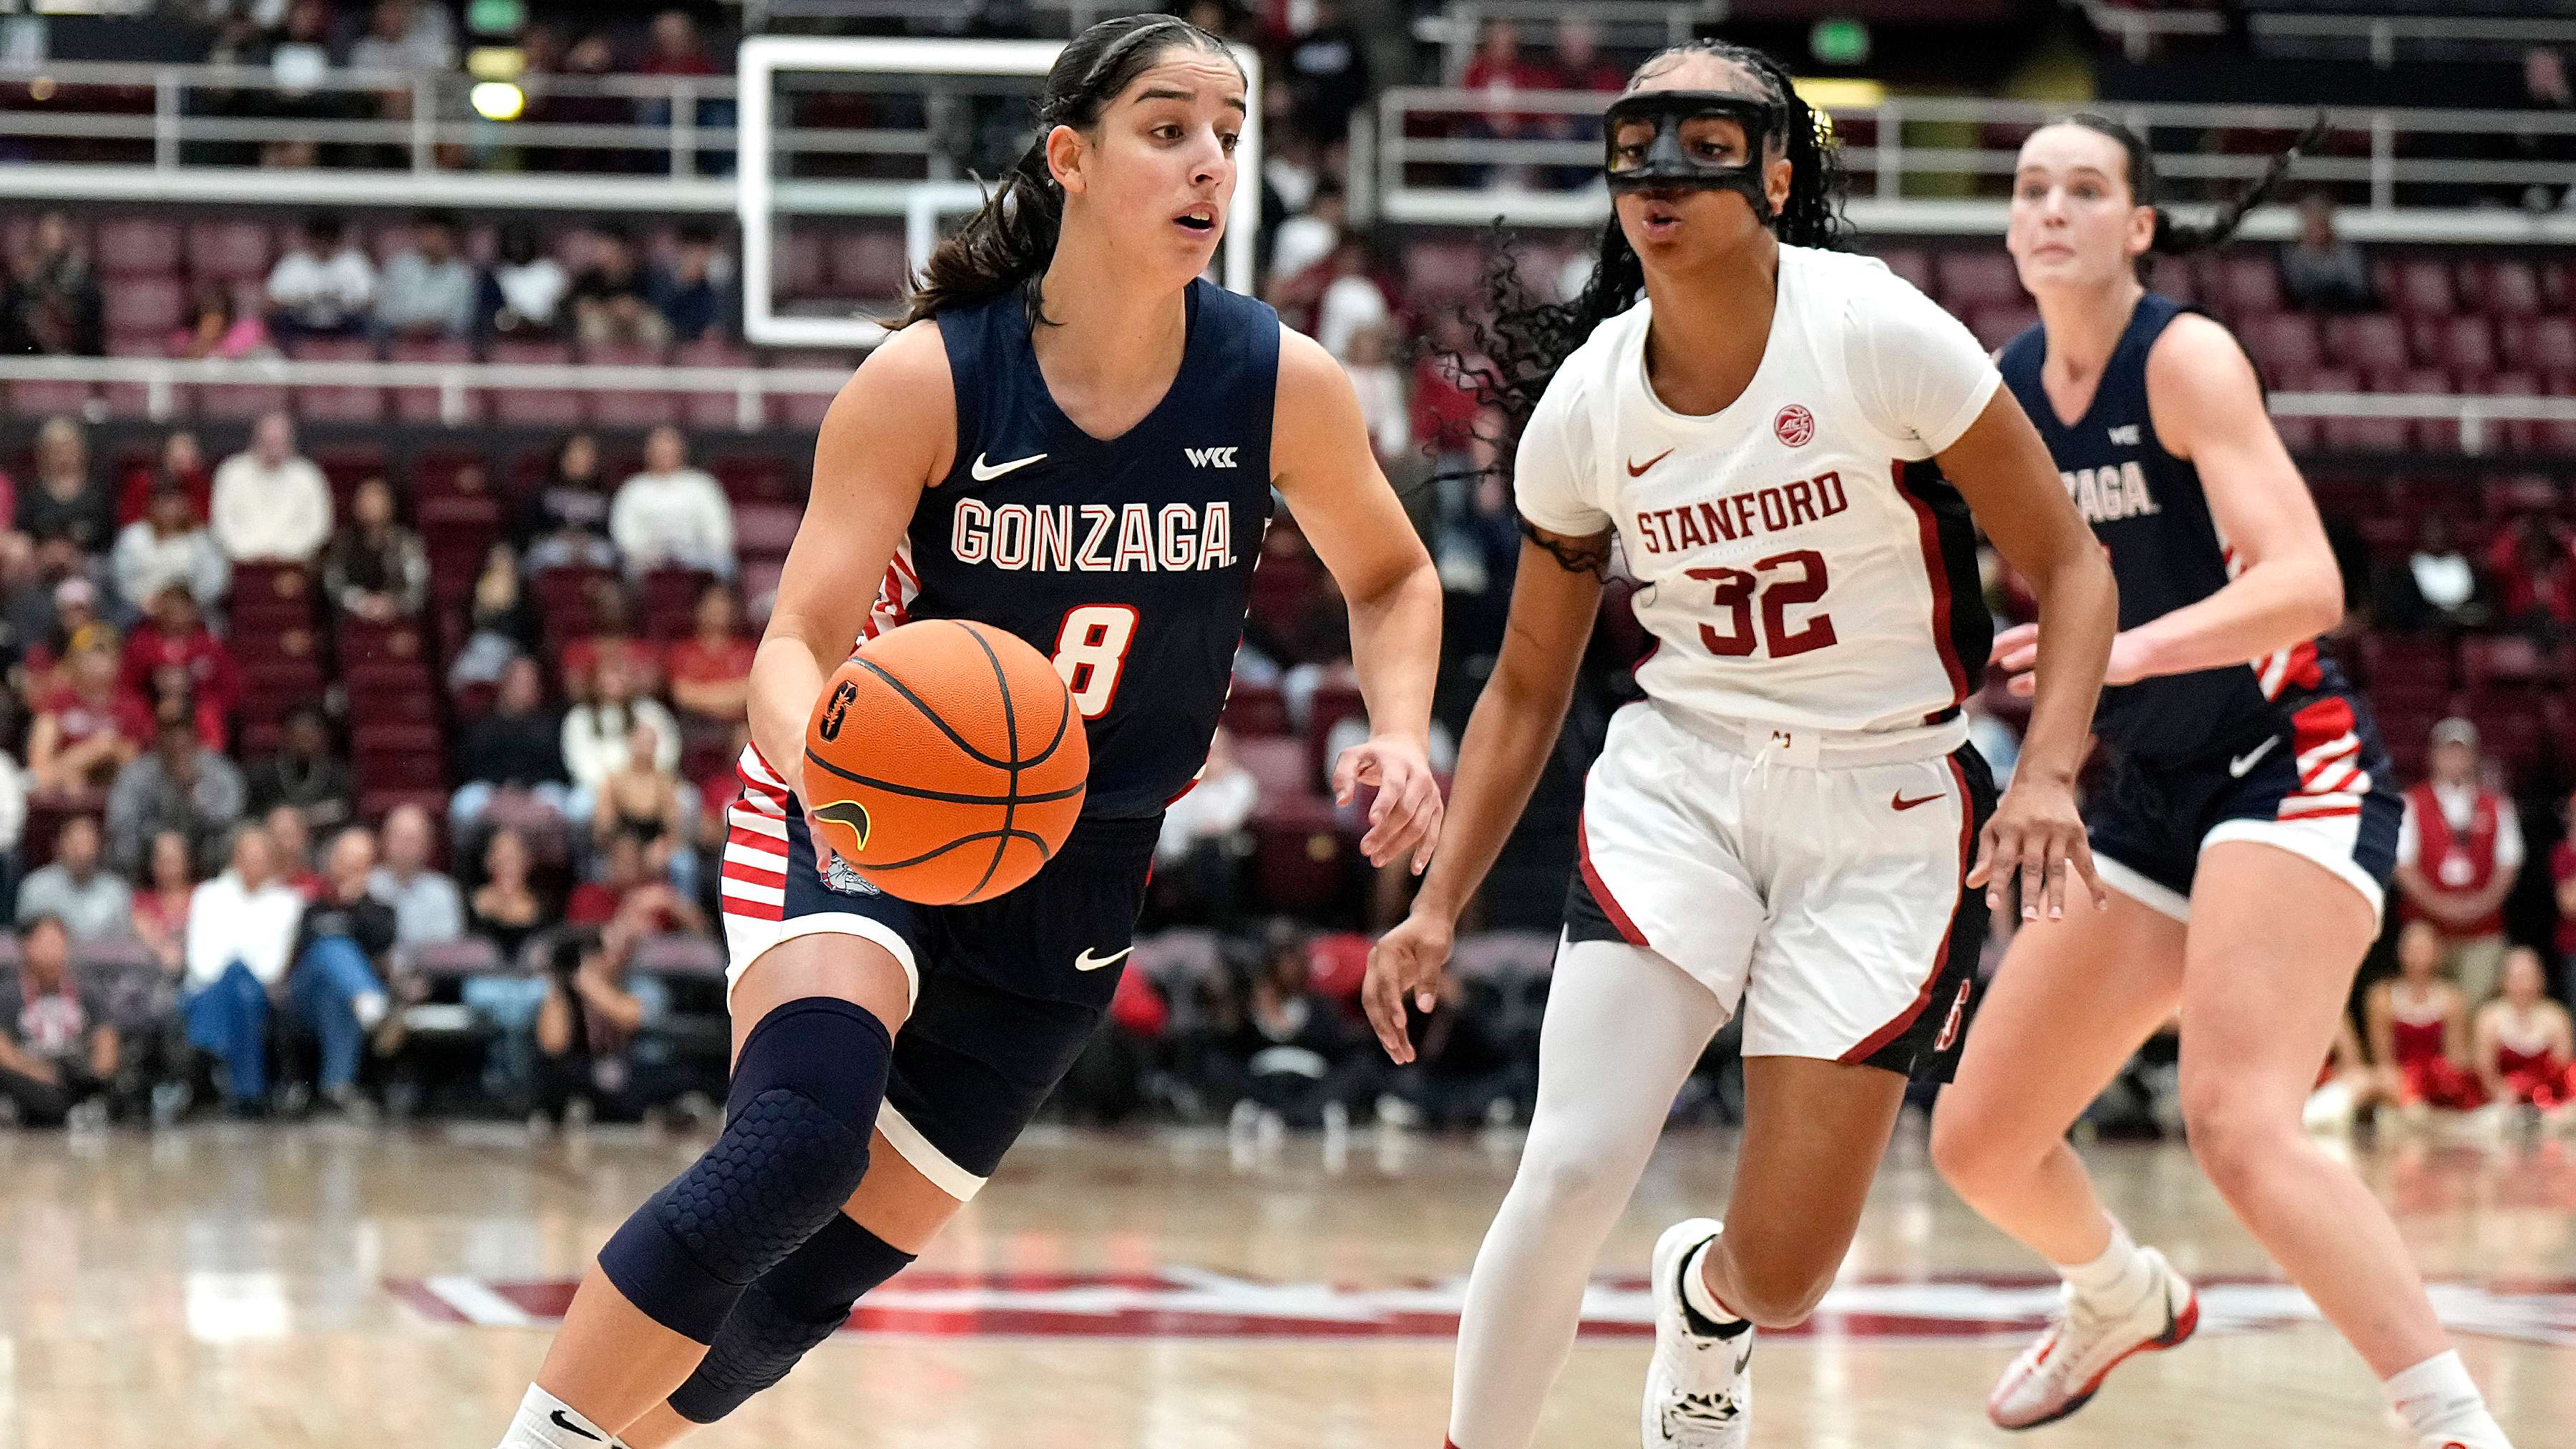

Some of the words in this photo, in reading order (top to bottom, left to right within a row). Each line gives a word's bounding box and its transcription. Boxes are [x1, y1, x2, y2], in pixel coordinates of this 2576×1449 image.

[1184, 447, 1239, 468] WCC
[1636, 470, 1848, 554] STANFORD
[1683, 549, 1838, 659] 32
[1050, 603, 1140, 720] 8
